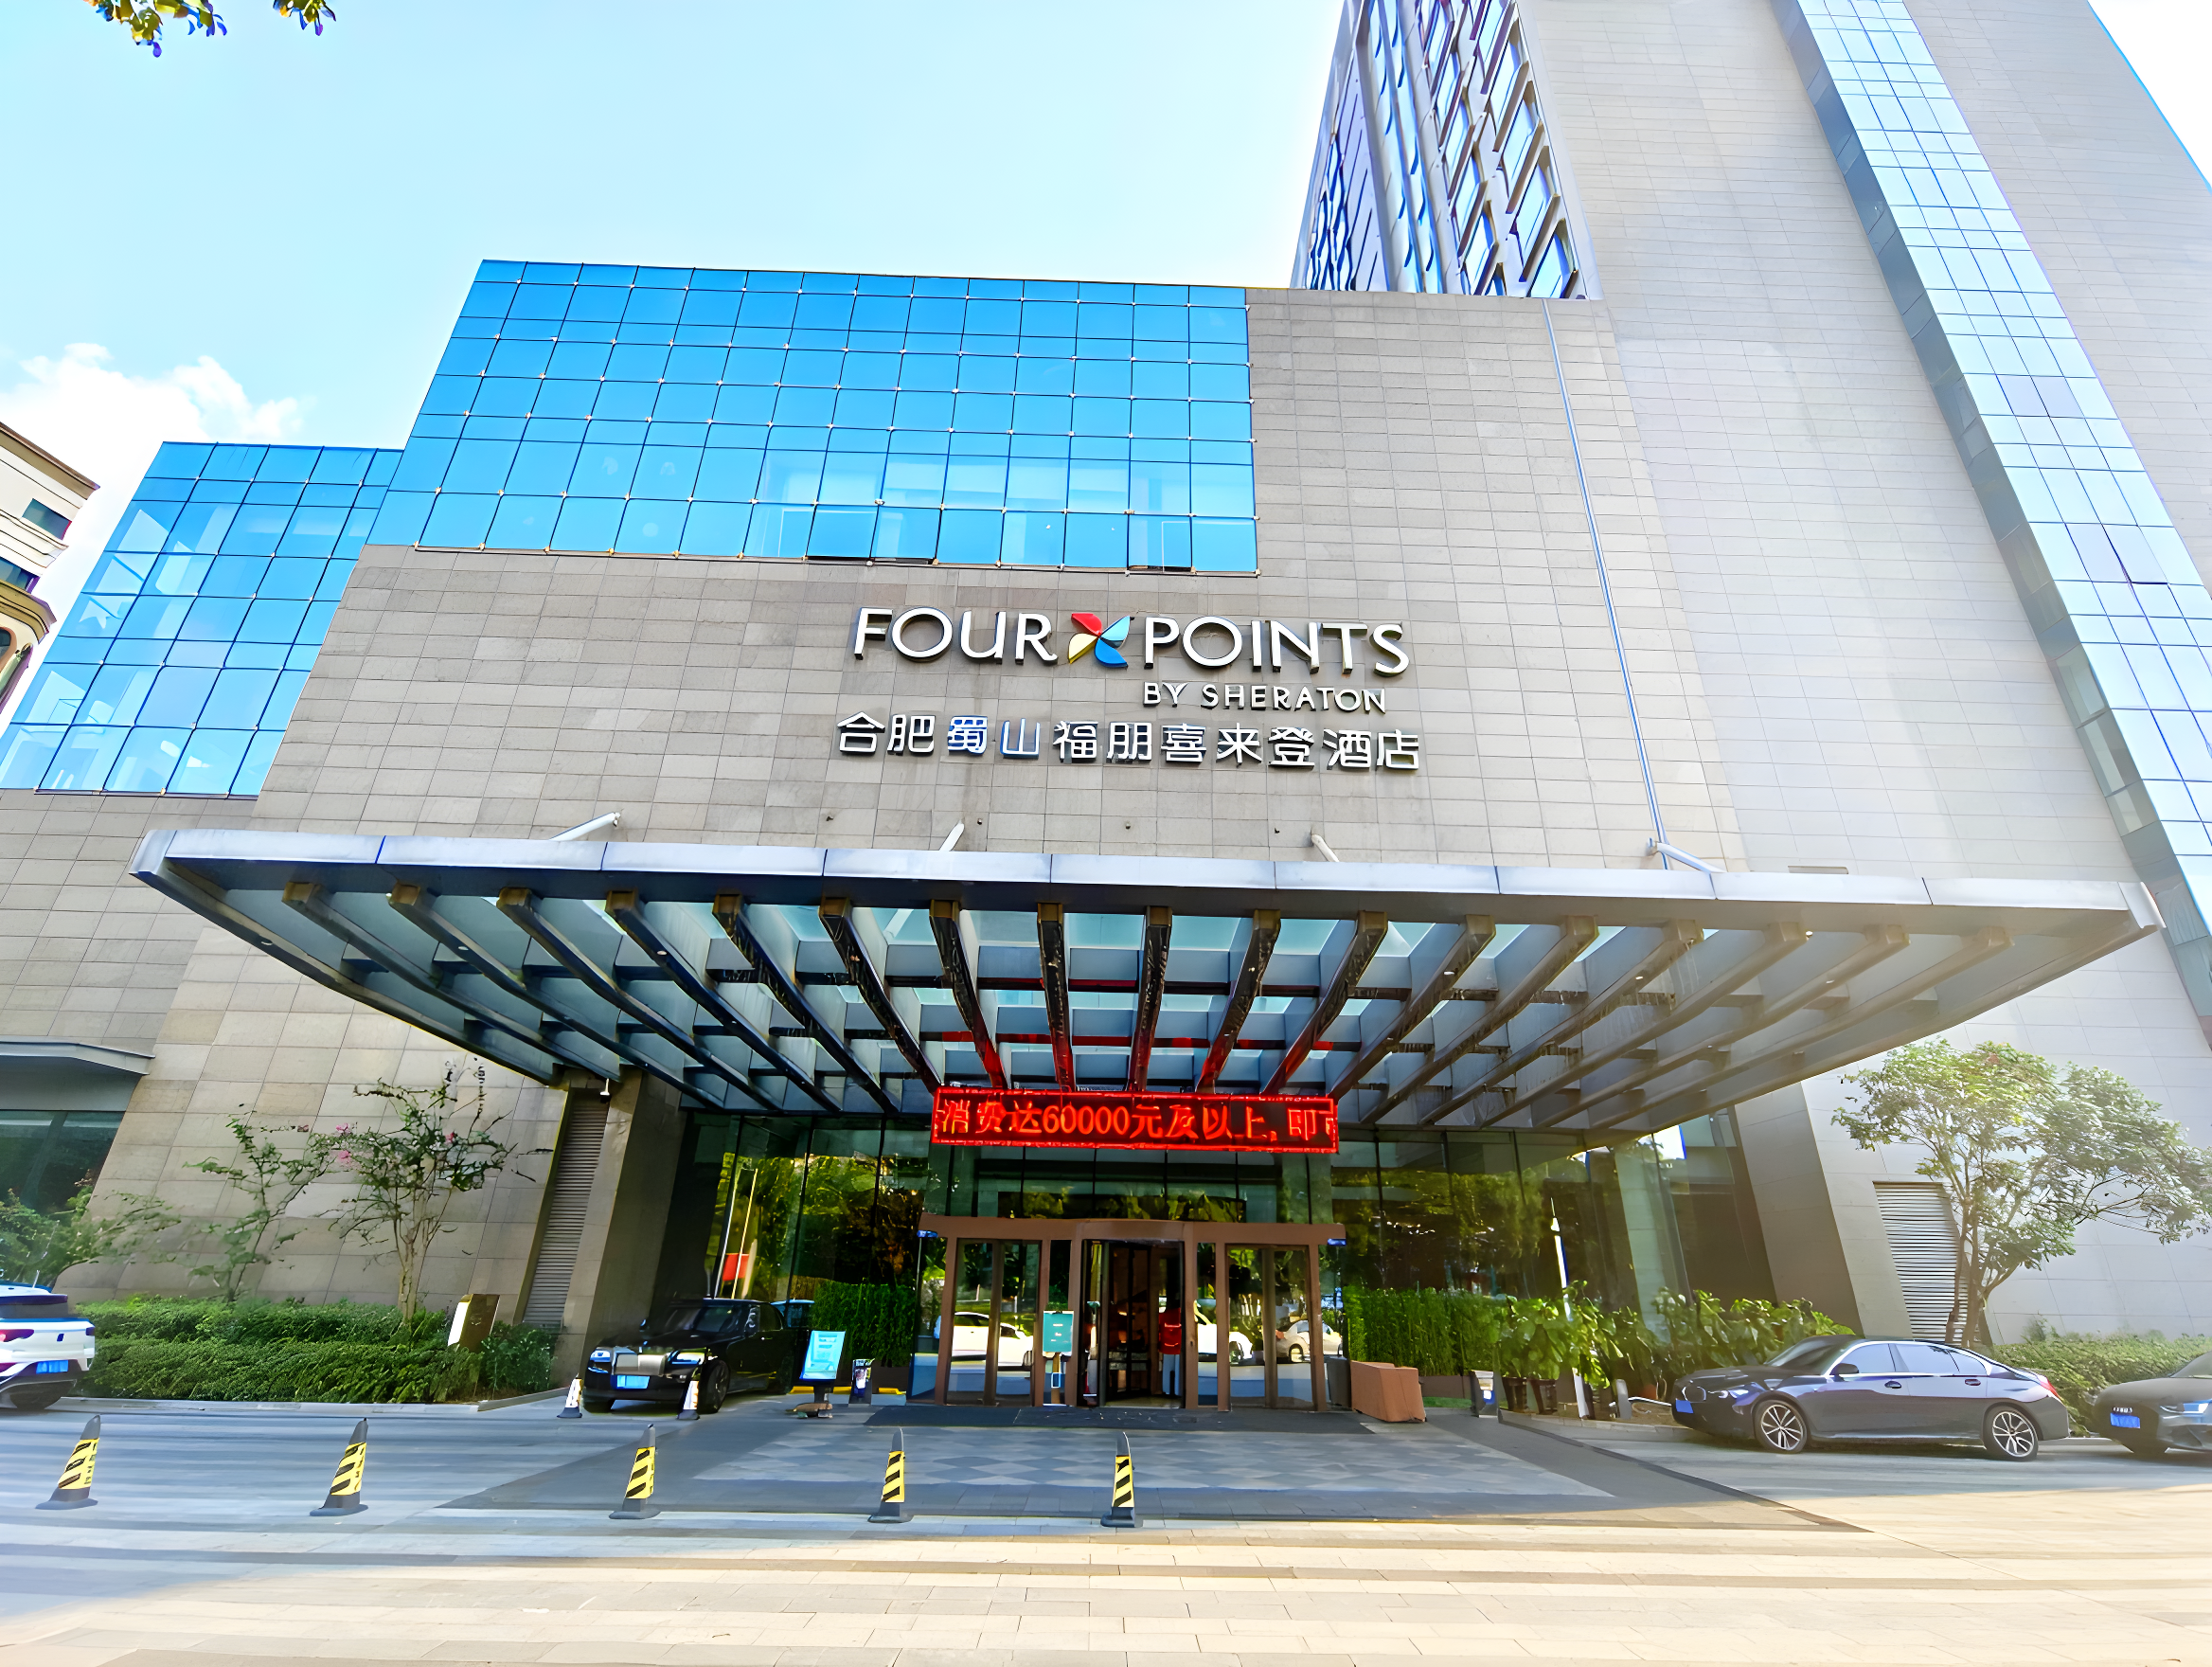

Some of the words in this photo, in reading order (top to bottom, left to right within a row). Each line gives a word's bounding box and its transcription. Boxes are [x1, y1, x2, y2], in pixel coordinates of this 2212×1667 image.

[853, 606, 1059, 664] FOUR
[1143, 615, 1411, 676] POINTS
[1142, 682, 1188, 707] BY
[1201, 683, 1387, 713] SHERATON
[836, 711, 1420, 771] 合肥蜀山福朋喜来登酒店
